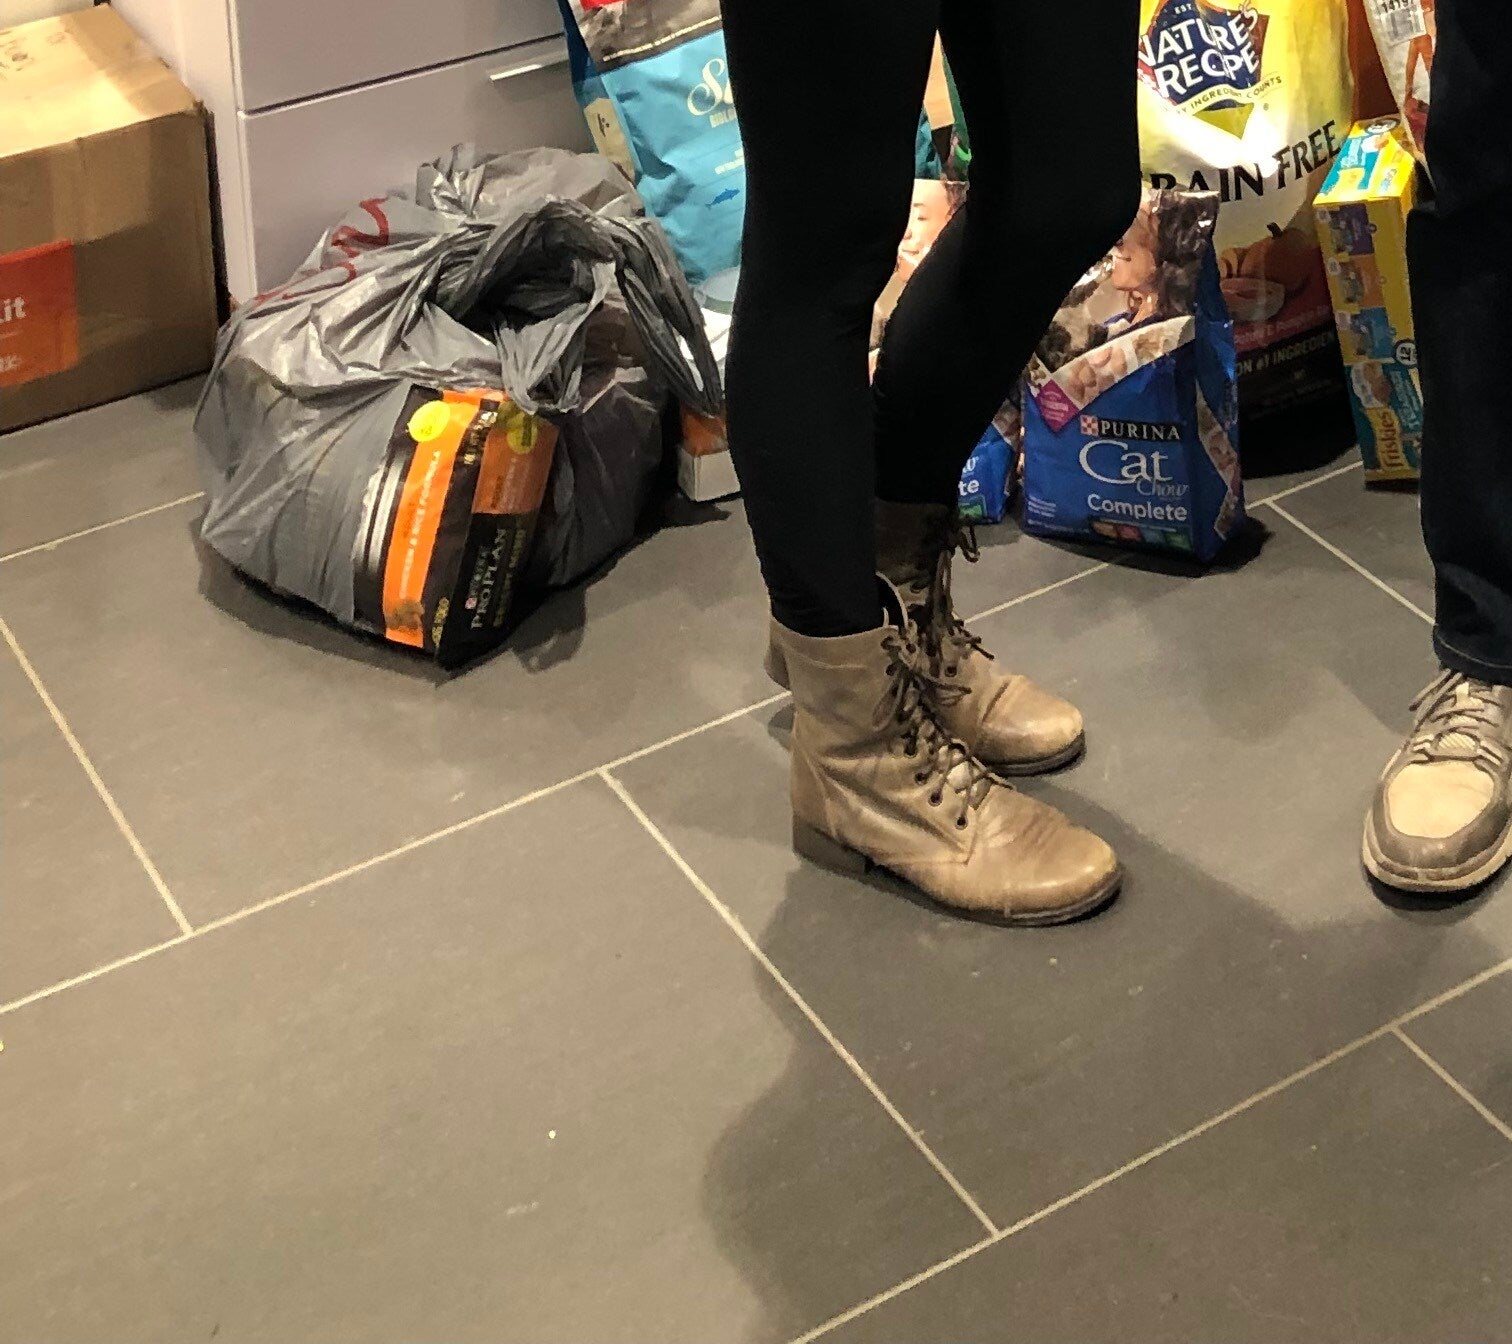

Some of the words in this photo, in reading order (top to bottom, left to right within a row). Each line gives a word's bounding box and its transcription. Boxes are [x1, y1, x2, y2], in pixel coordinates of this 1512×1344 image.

[1150, 163, 1264, 202] RAIN
[1272, 120, 1341, 189] FREE
[1101, 420, 1180, 440] PURINA
[1079, 439, 1173, 484] Cat
[1137, 477, 1190, 496] Chow
[1088, 493, 1188, 522] Complete
